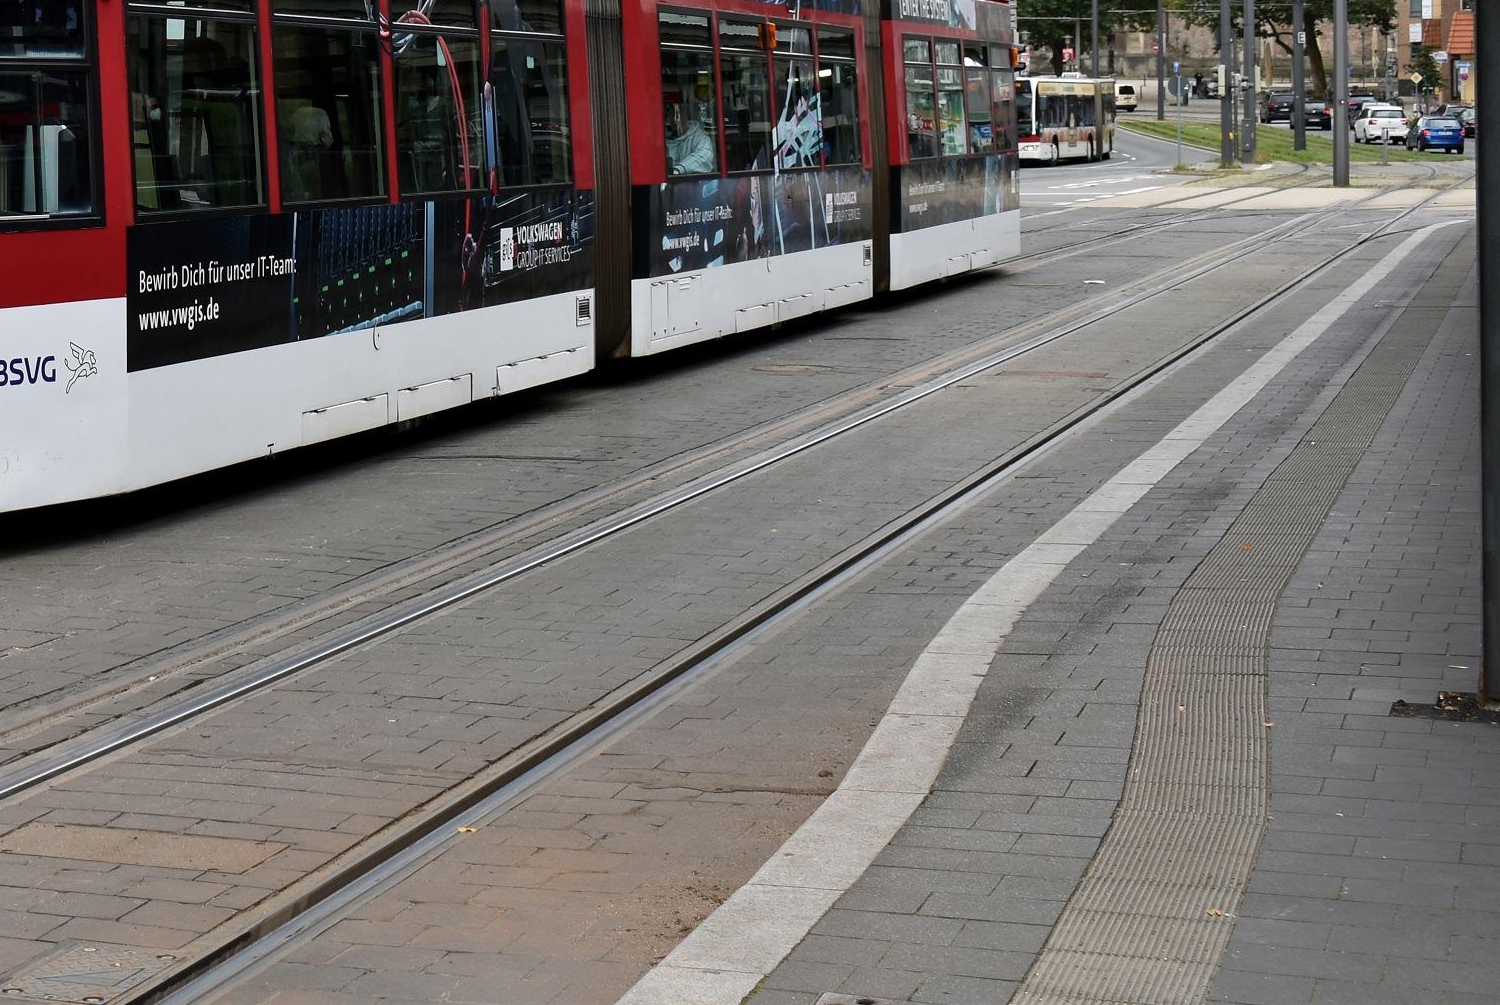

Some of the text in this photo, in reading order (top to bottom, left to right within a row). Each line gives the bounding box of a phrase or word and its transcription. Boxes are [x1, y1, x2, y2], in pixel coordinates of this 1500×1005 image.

[516, 221, 564, 245] VOLKSWAGEN
[516, 245, 571, 269] GROUP IT SERVICES
[139, 254, 298, 294] Bewirb Dich für unser IT-Team:
[138, 296, 220, 331] www.vwgis.de
